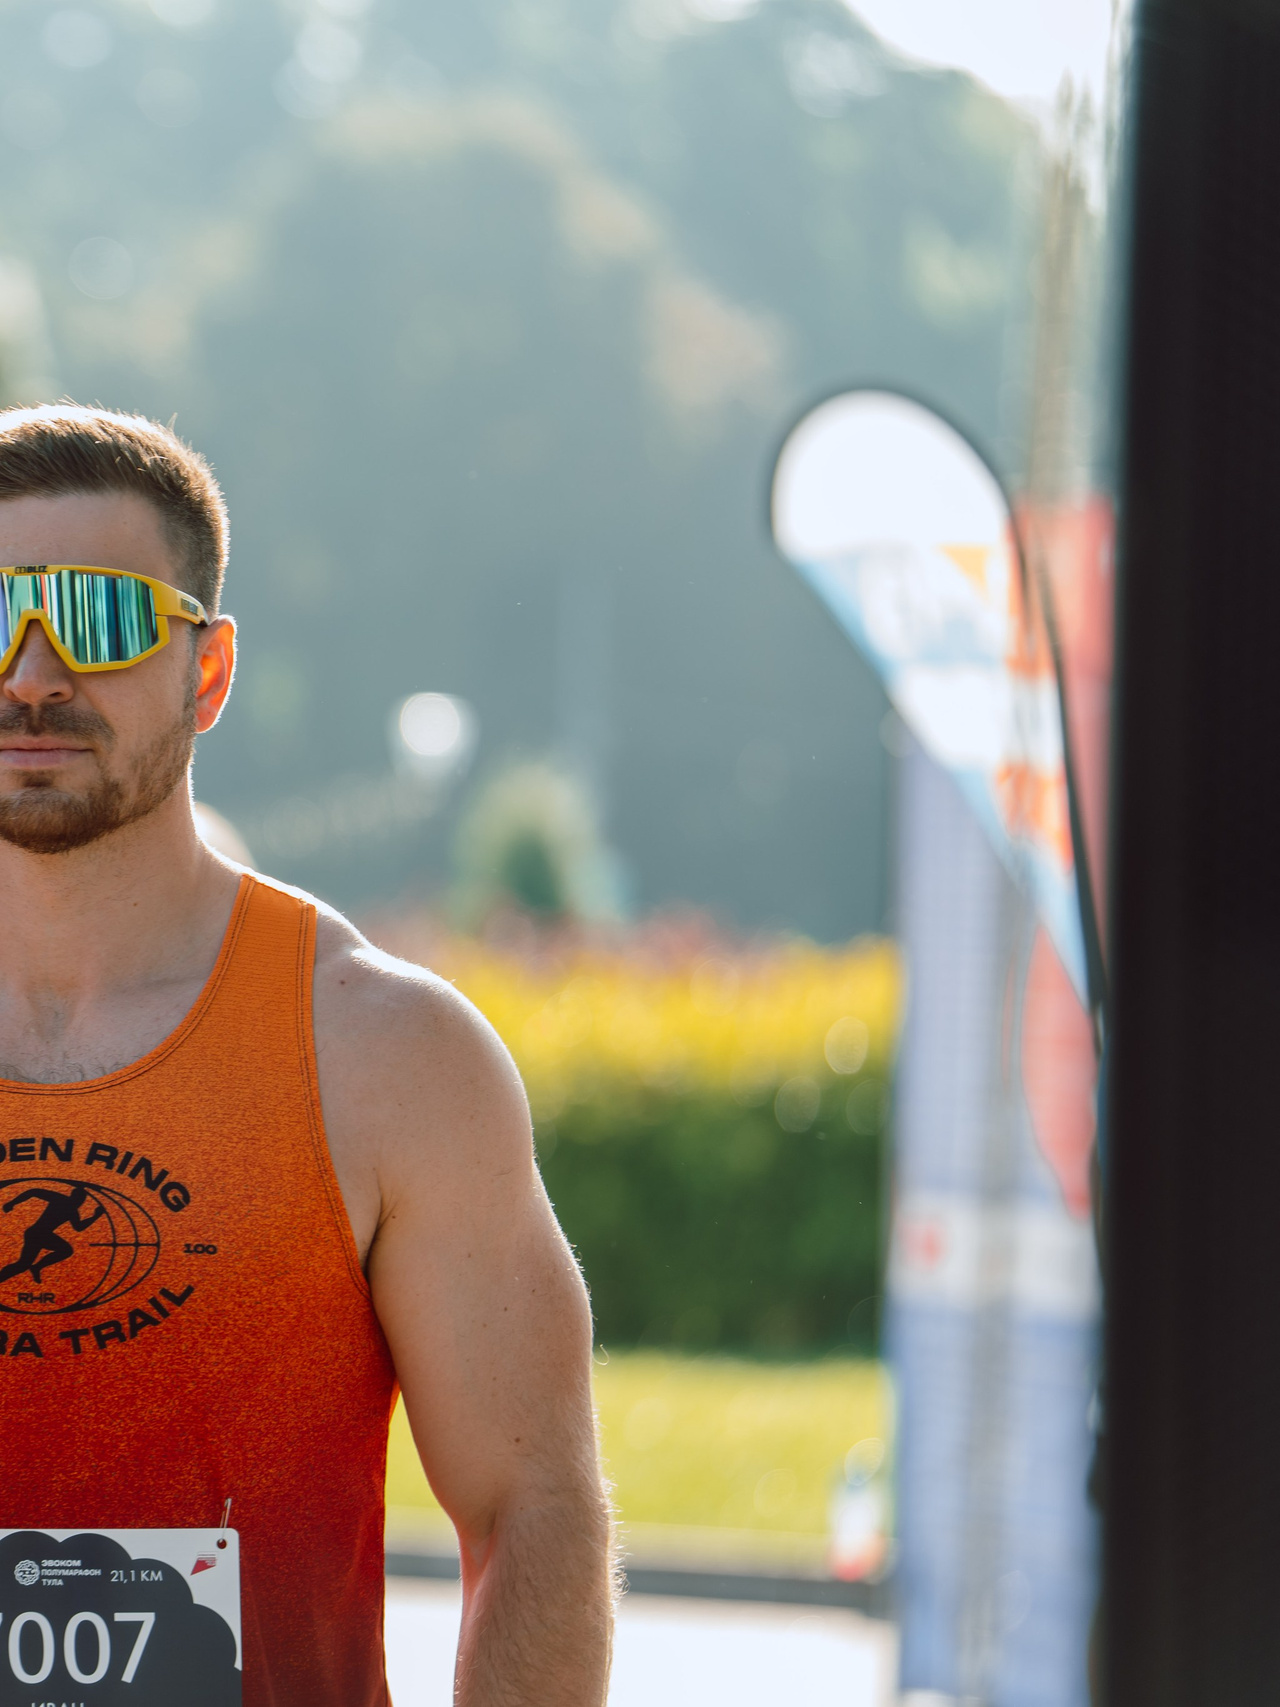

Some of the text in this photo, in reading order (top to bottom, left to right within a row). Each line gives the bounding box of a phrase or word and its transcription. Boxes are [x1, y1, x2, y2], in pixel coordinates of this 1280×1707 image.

[85, 1141, 191, 1213] RING
[183, 1243, 218, 1255] 100
[17, 1292, 56, 1304] RHR
[59, 1282, 195, 1356] TRAIL
[41, 1559, 82, 1567] ЭВОКОМ
[41, 1568, 102, 1577] ПОЛУМАРАФОН
[110, 1569, 136, 1584] 21,1
[41, 1578, 64, 1586] ТУЛА
